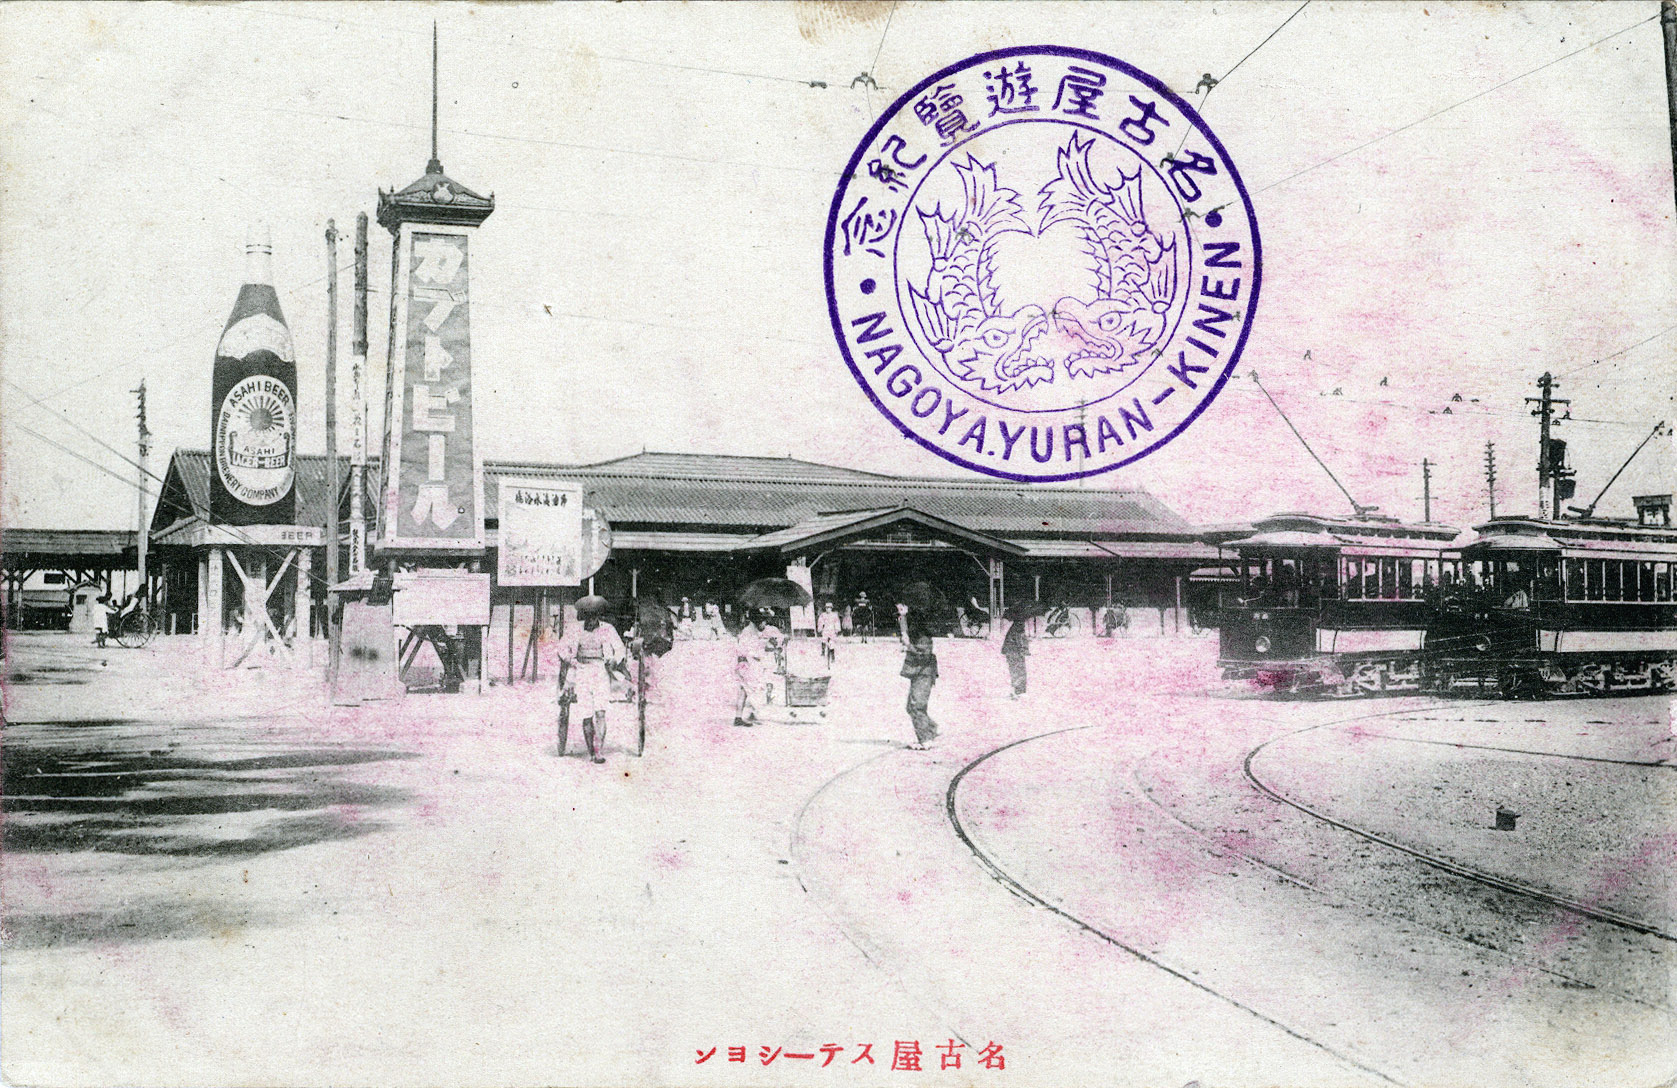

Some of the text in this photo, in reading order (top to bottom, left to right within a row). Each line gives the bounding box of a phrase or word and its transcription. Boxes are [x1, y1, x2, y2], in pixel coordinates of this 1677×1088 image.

[229, 381, 290, 408] ASAHI BEER
[410, 238, 467, 532] カブトビール
[243, 446, 275, 456] ASAHI
[219, 457, 242, 491] BREWERY
[240, 486, 279, 500] COMPANY
[281, 530, 314, 541] BEER
